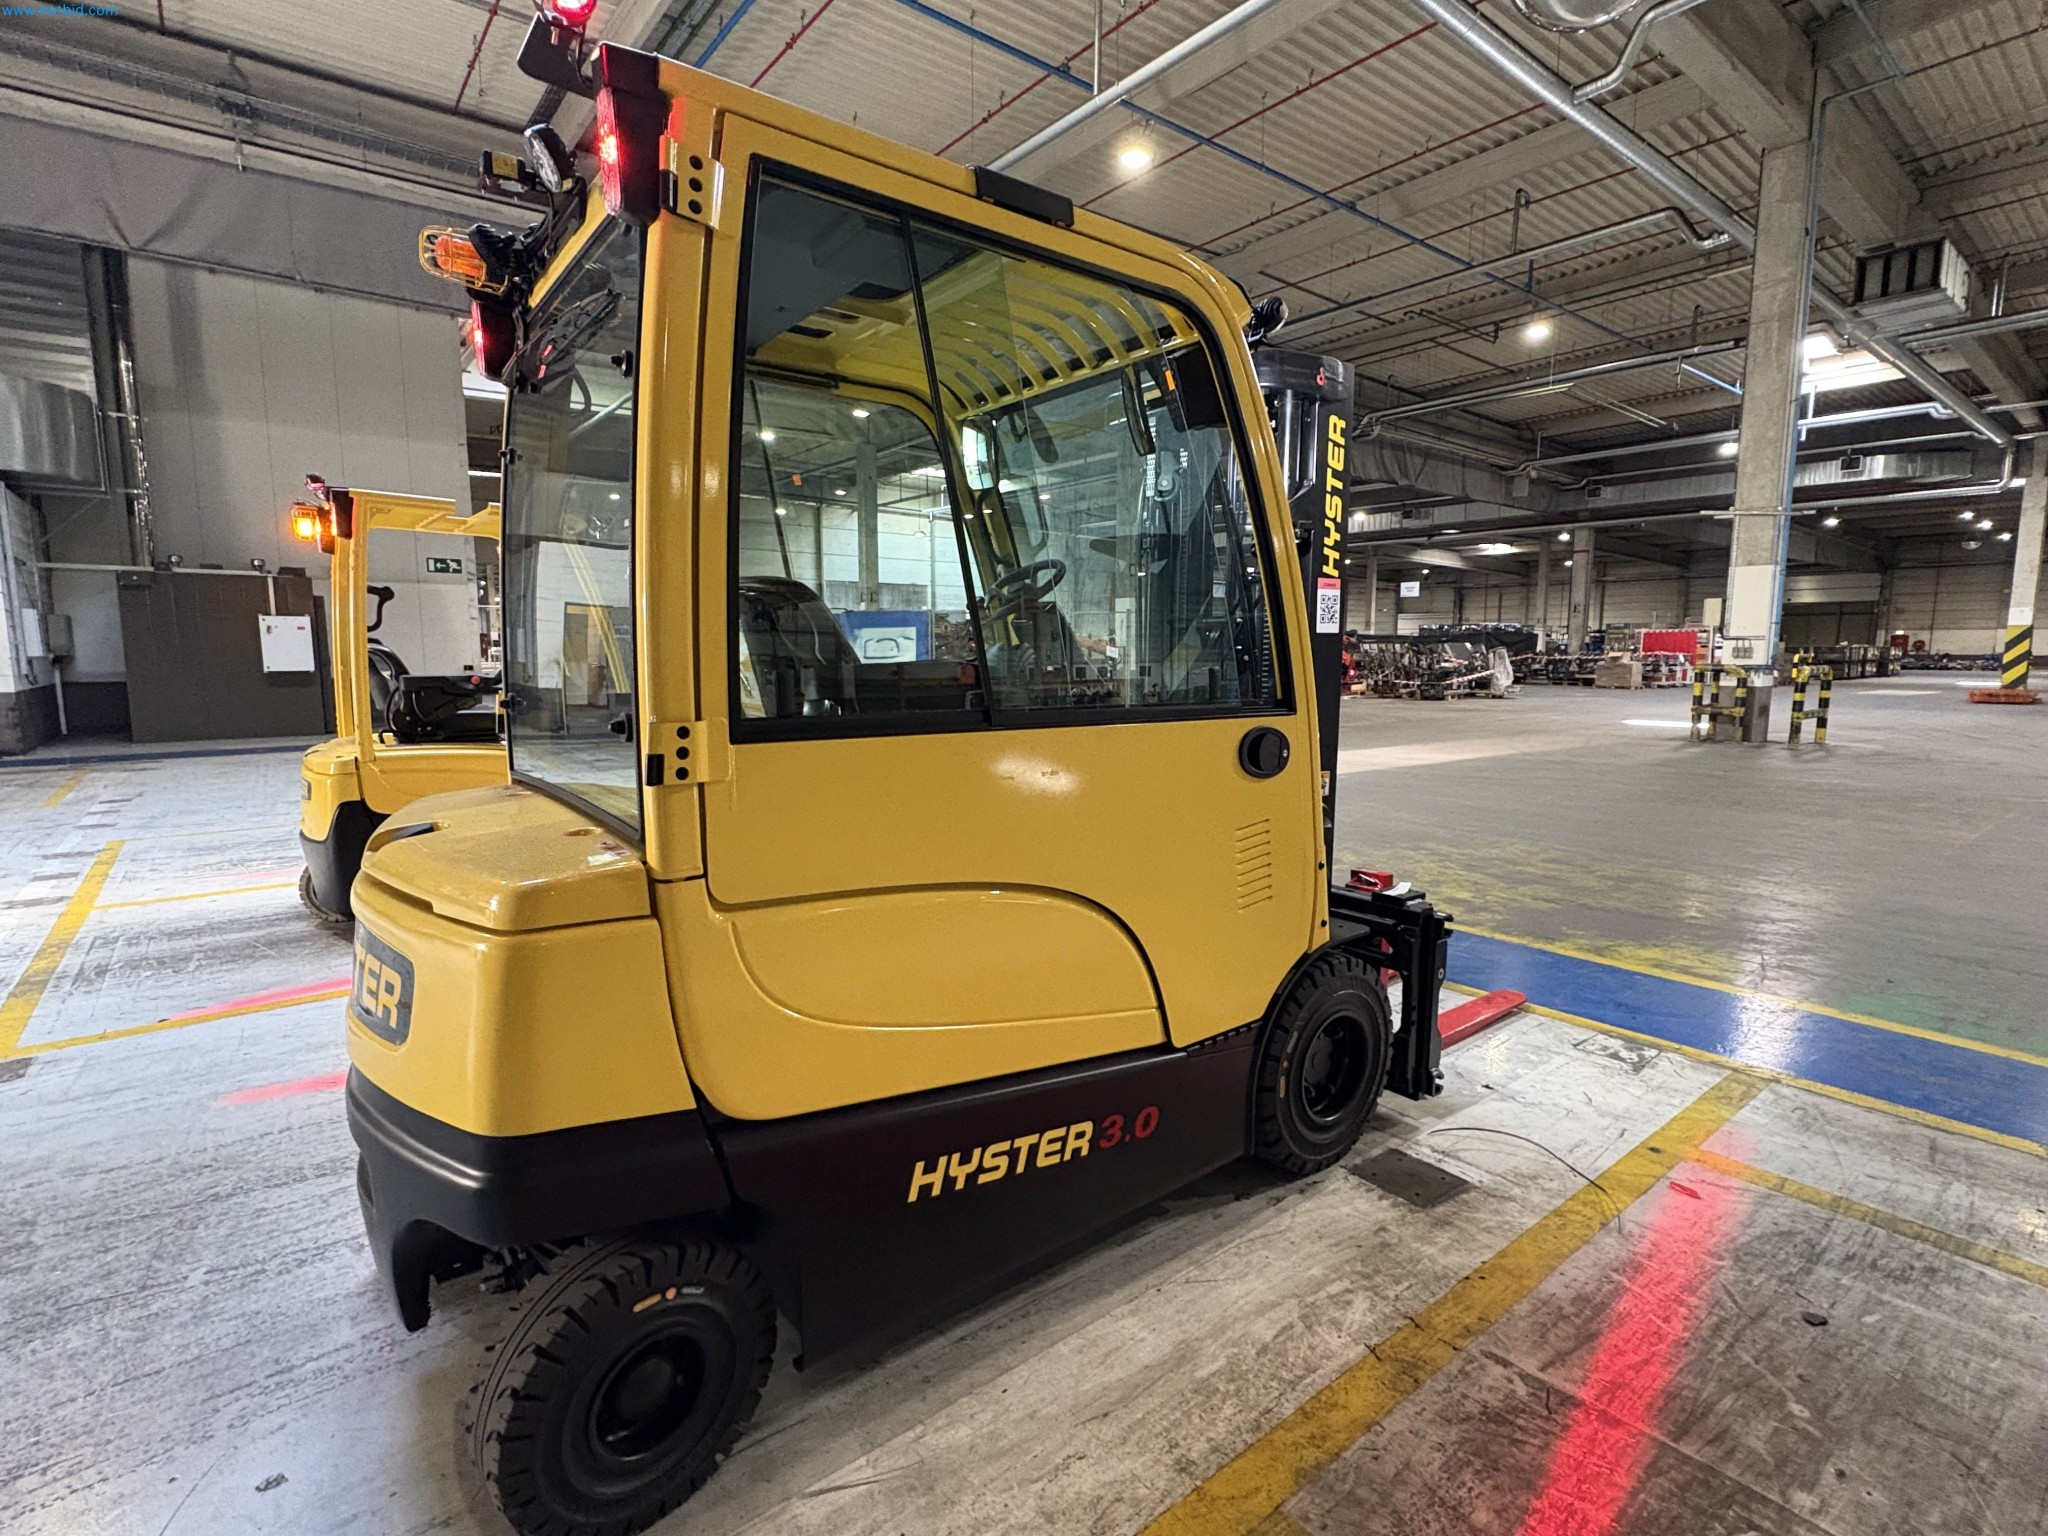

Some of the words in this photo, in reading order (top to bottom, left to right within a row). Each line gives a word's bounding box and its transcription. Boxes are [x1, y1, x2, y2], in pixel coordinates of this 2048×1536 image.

[1322, 414, 1346, 577] HYSTER
[907, 1120, 1093, 1203] HYSTER
[1098, 1105, 1159, 1148] 3.0
